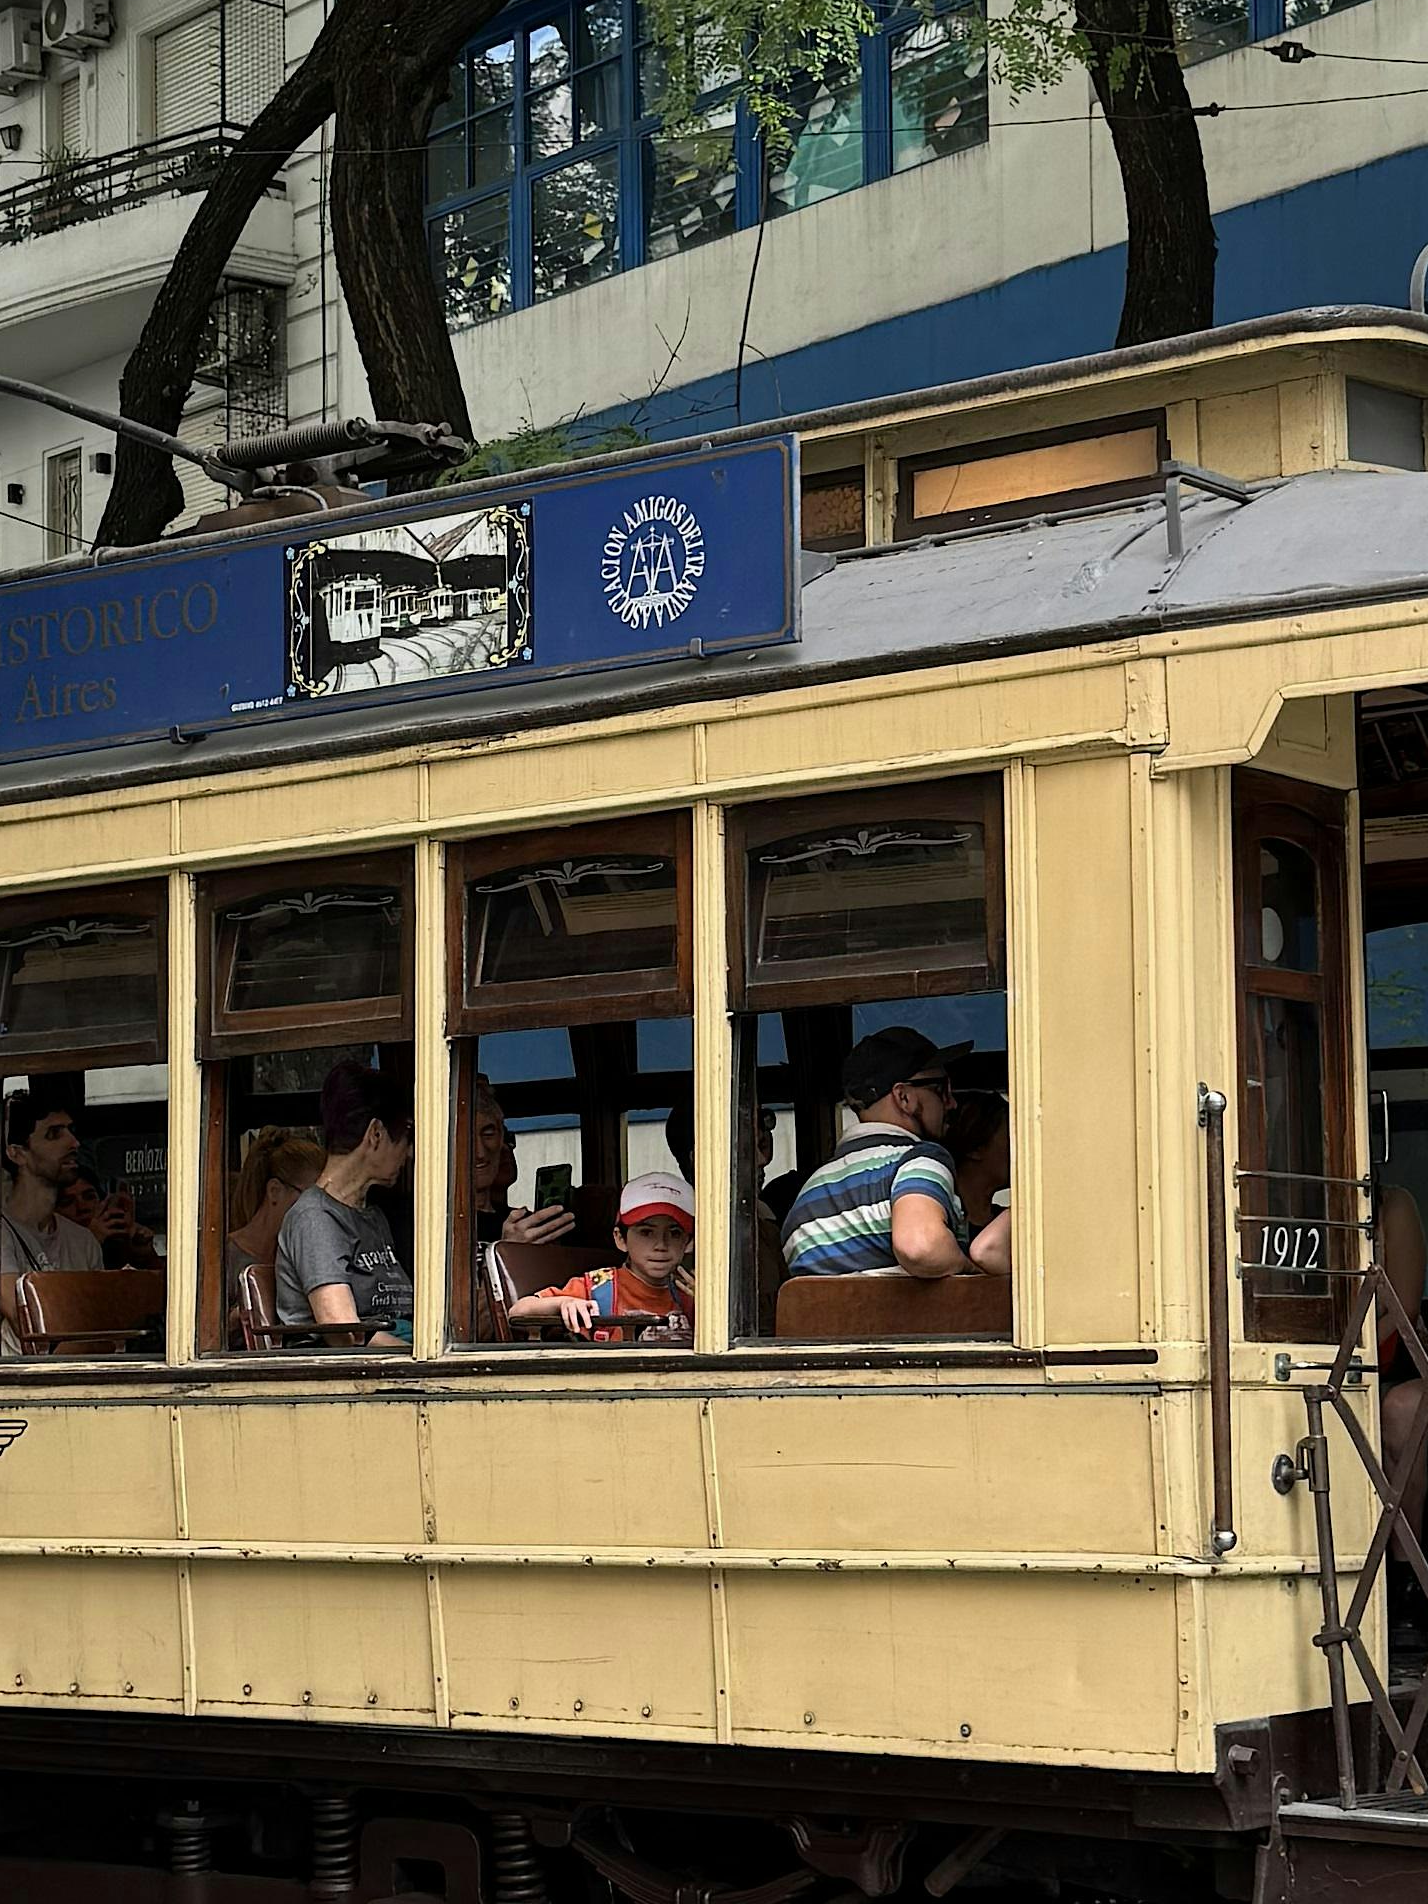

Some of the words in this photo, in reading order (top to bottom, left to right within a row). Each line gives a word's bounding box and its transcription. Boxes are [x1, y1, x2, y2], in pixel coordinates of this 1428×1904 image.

[623, 495, 688, 535] AMIGOS
[677, 512, 704, 556] DEL
[601, 525, 653, 630] ASOCIACION
[652, 551, 706, 628] TRANVIA
[15, 674, 118, 724] Aires
[1261, 1225, 1320, 1269] 1912
